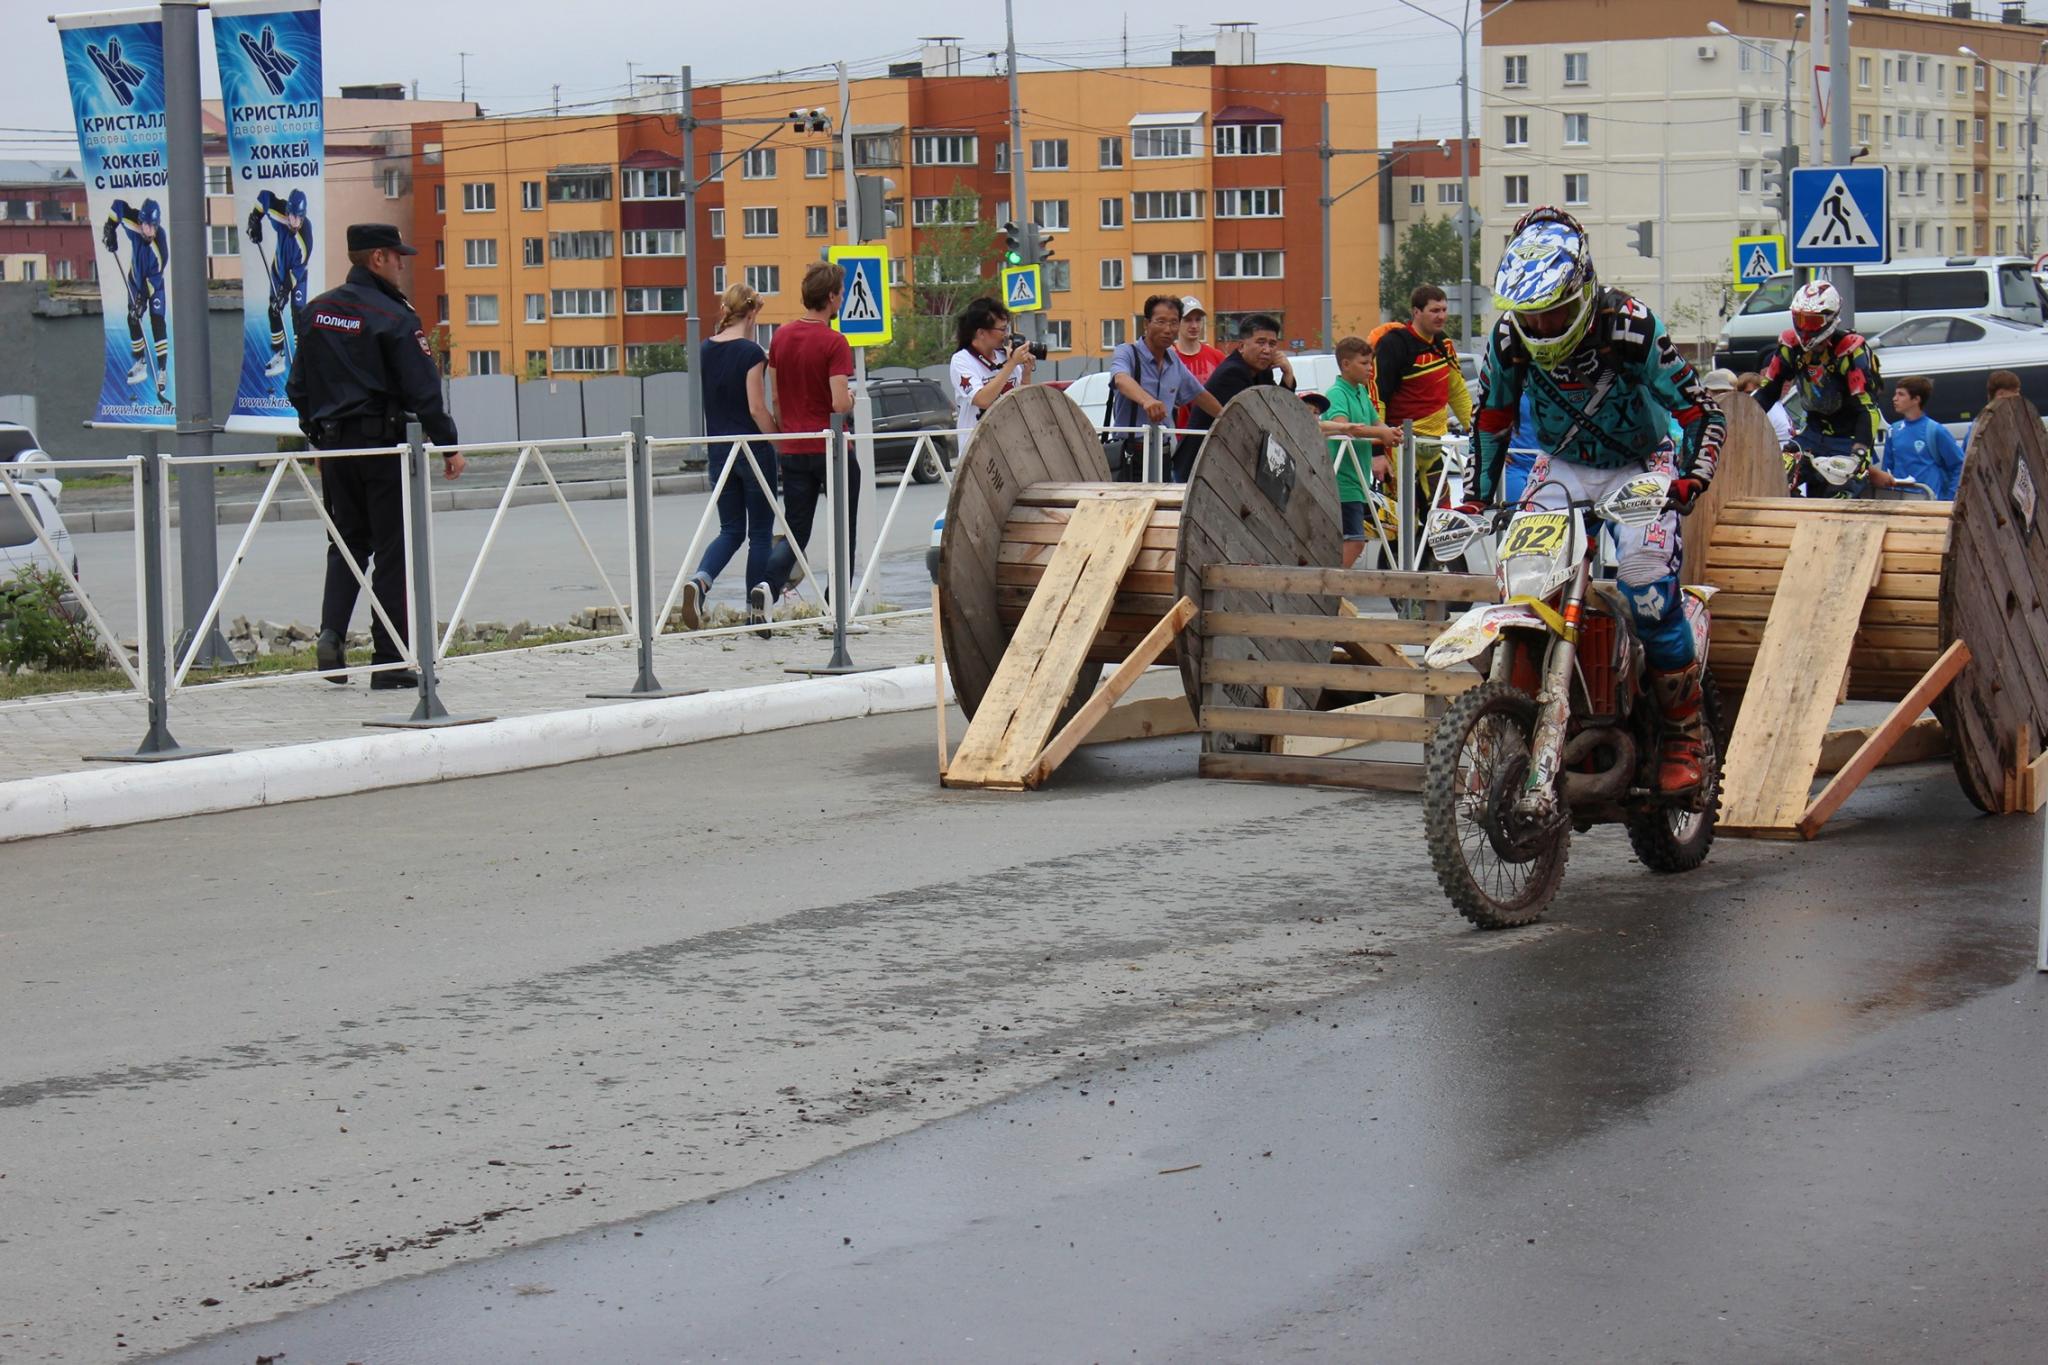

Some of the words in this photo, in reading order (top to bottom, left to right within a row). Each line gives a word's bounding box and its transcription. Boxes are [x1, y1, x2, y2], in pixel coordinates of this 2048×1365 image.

[232, 103, 319, 122] КРИСТАЛЛ
[235, 124, 278, 136] дворец
[282, 121, 320, 133] спорта
[86, 134, 128, 148] дворец
[250, 140, 310, 160] ХОККЕЙ
[101, 149, 160, 170] ХОККЕЙ
[241, 165, 253, 180] С
[257, 158, 319, 179] ШАЙБОЙ
[95, 175, 106, 190] С
[109, 168, 169, 189] ШАЙБОЙ
[316, 314, 361, 331] ПОЛИЦИЯ
[1509, 525, 1556, 552] 82
